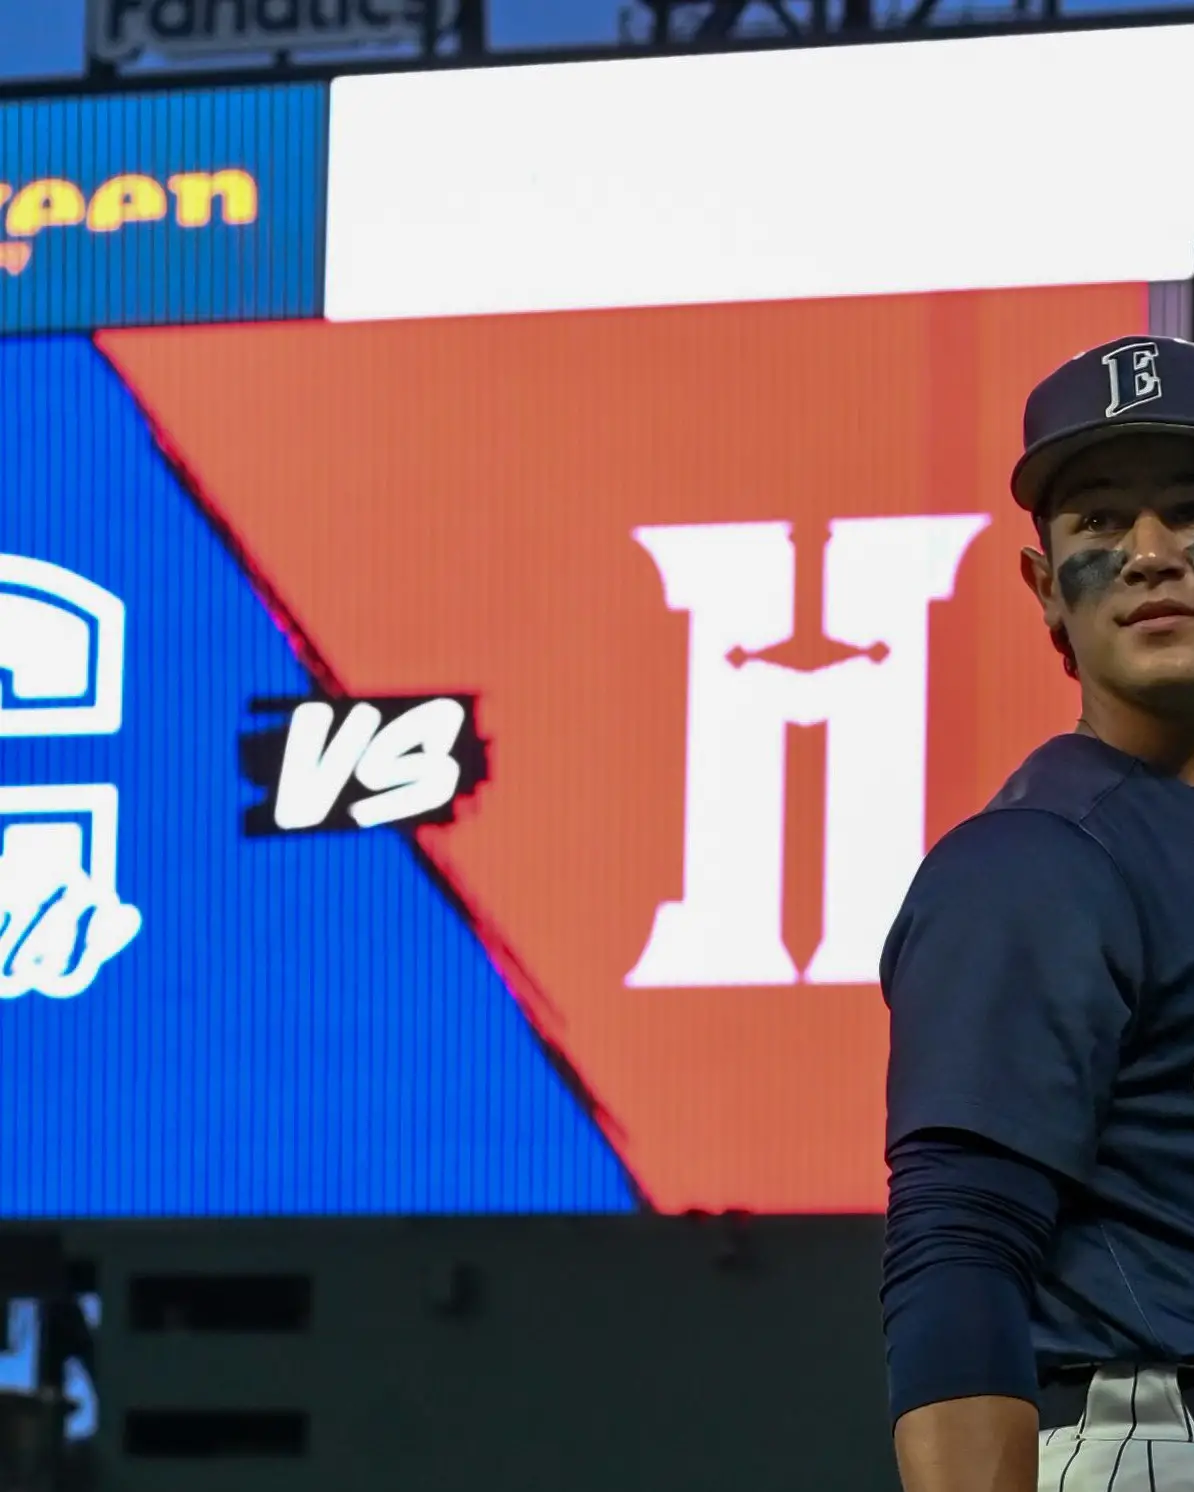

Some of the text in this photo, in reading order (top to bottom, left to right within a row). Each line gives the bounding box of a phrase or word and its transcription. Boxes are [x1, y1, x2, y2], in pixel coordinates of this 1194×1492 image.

[1102, 341, 1163, 418] E
[274, 697, 465, 830] VS
[623, 511, 992, 988] H
